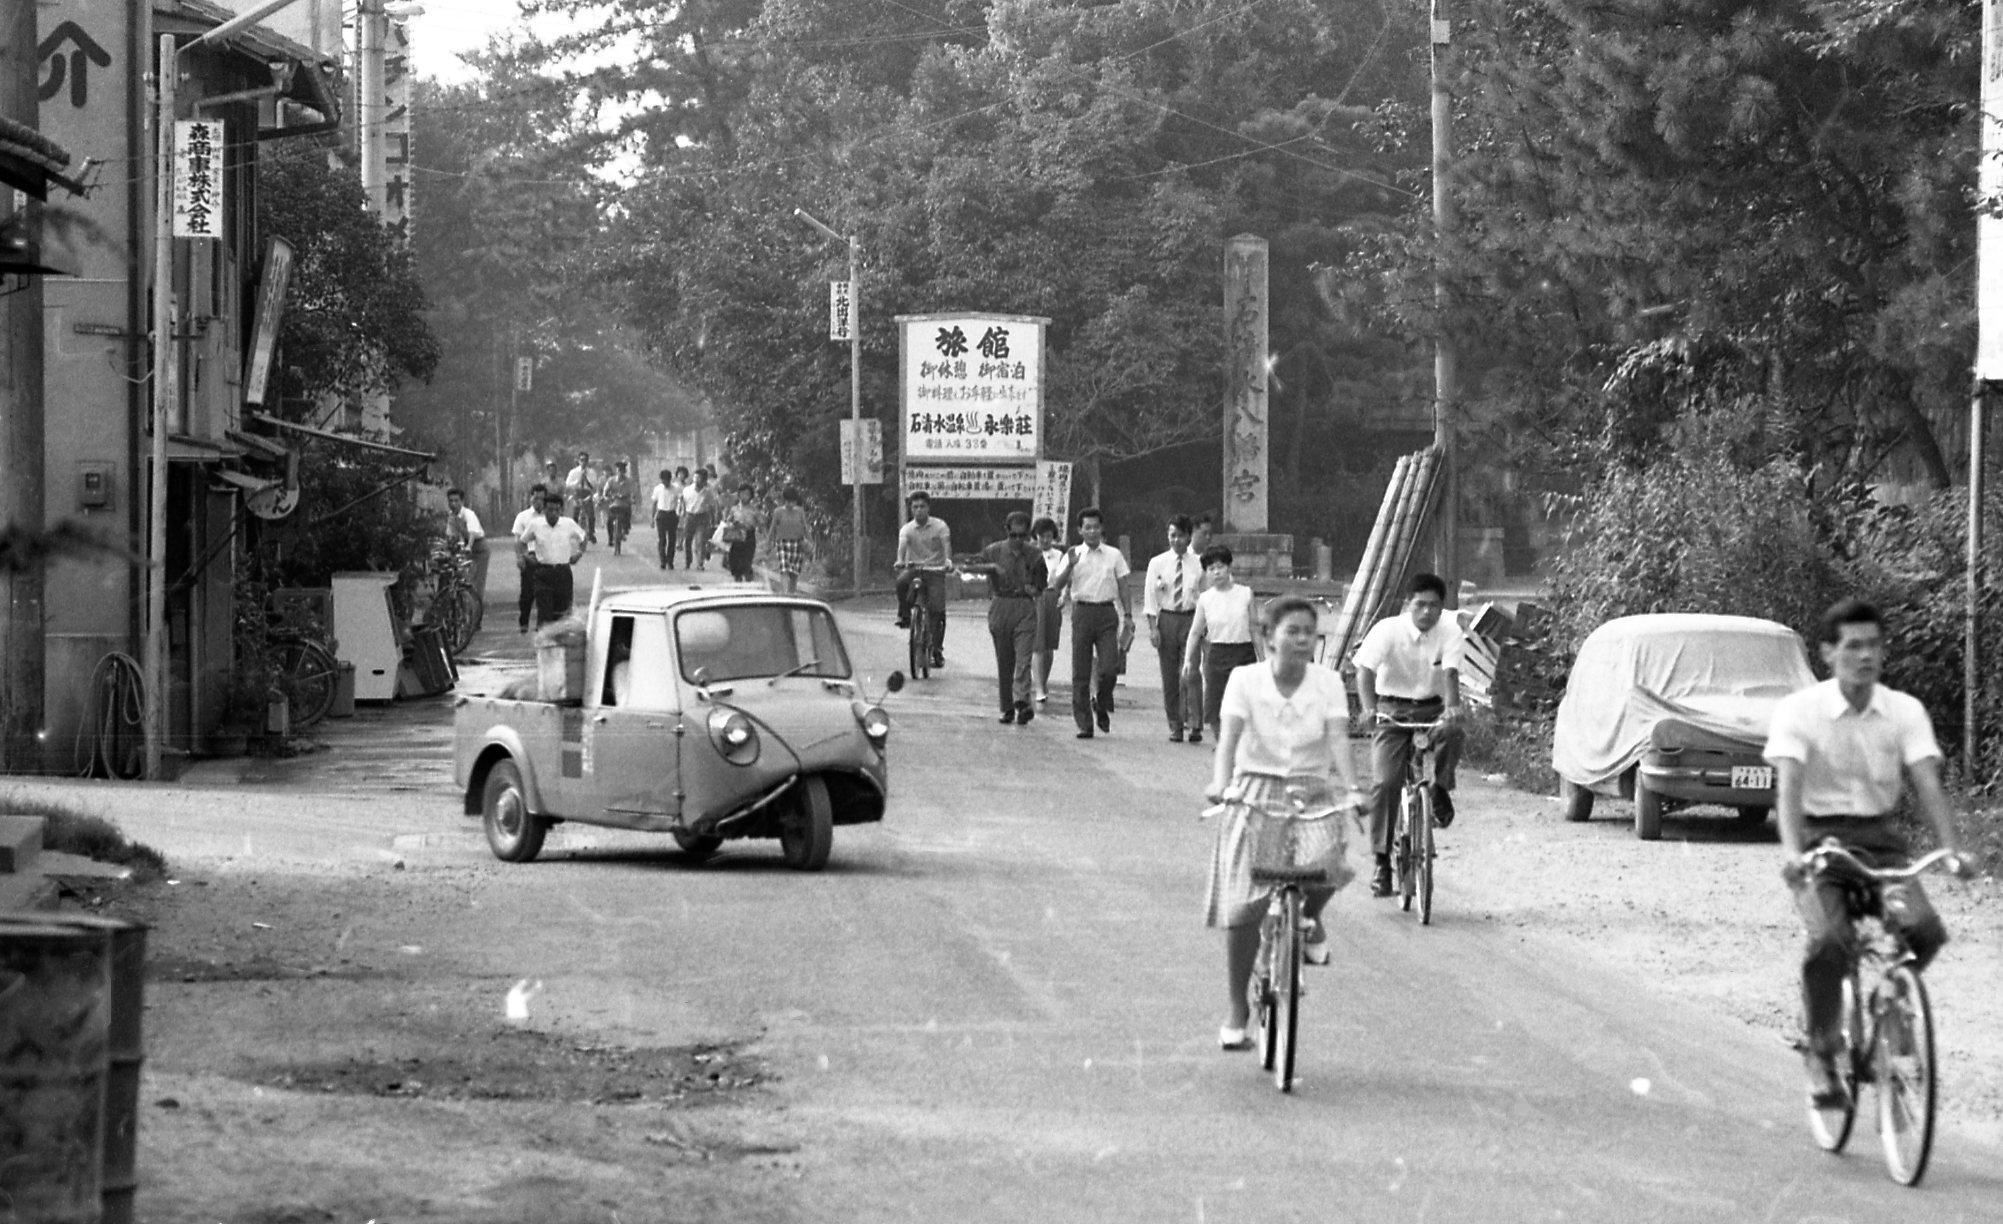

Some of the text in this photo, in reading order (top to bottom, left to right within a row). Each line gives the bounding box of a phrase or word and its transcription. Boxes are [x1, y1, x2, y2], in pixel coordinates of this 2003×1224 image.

[935, 325, 1010, 359] 旅館
[910, 412, 965, 435] 石清水温泉
